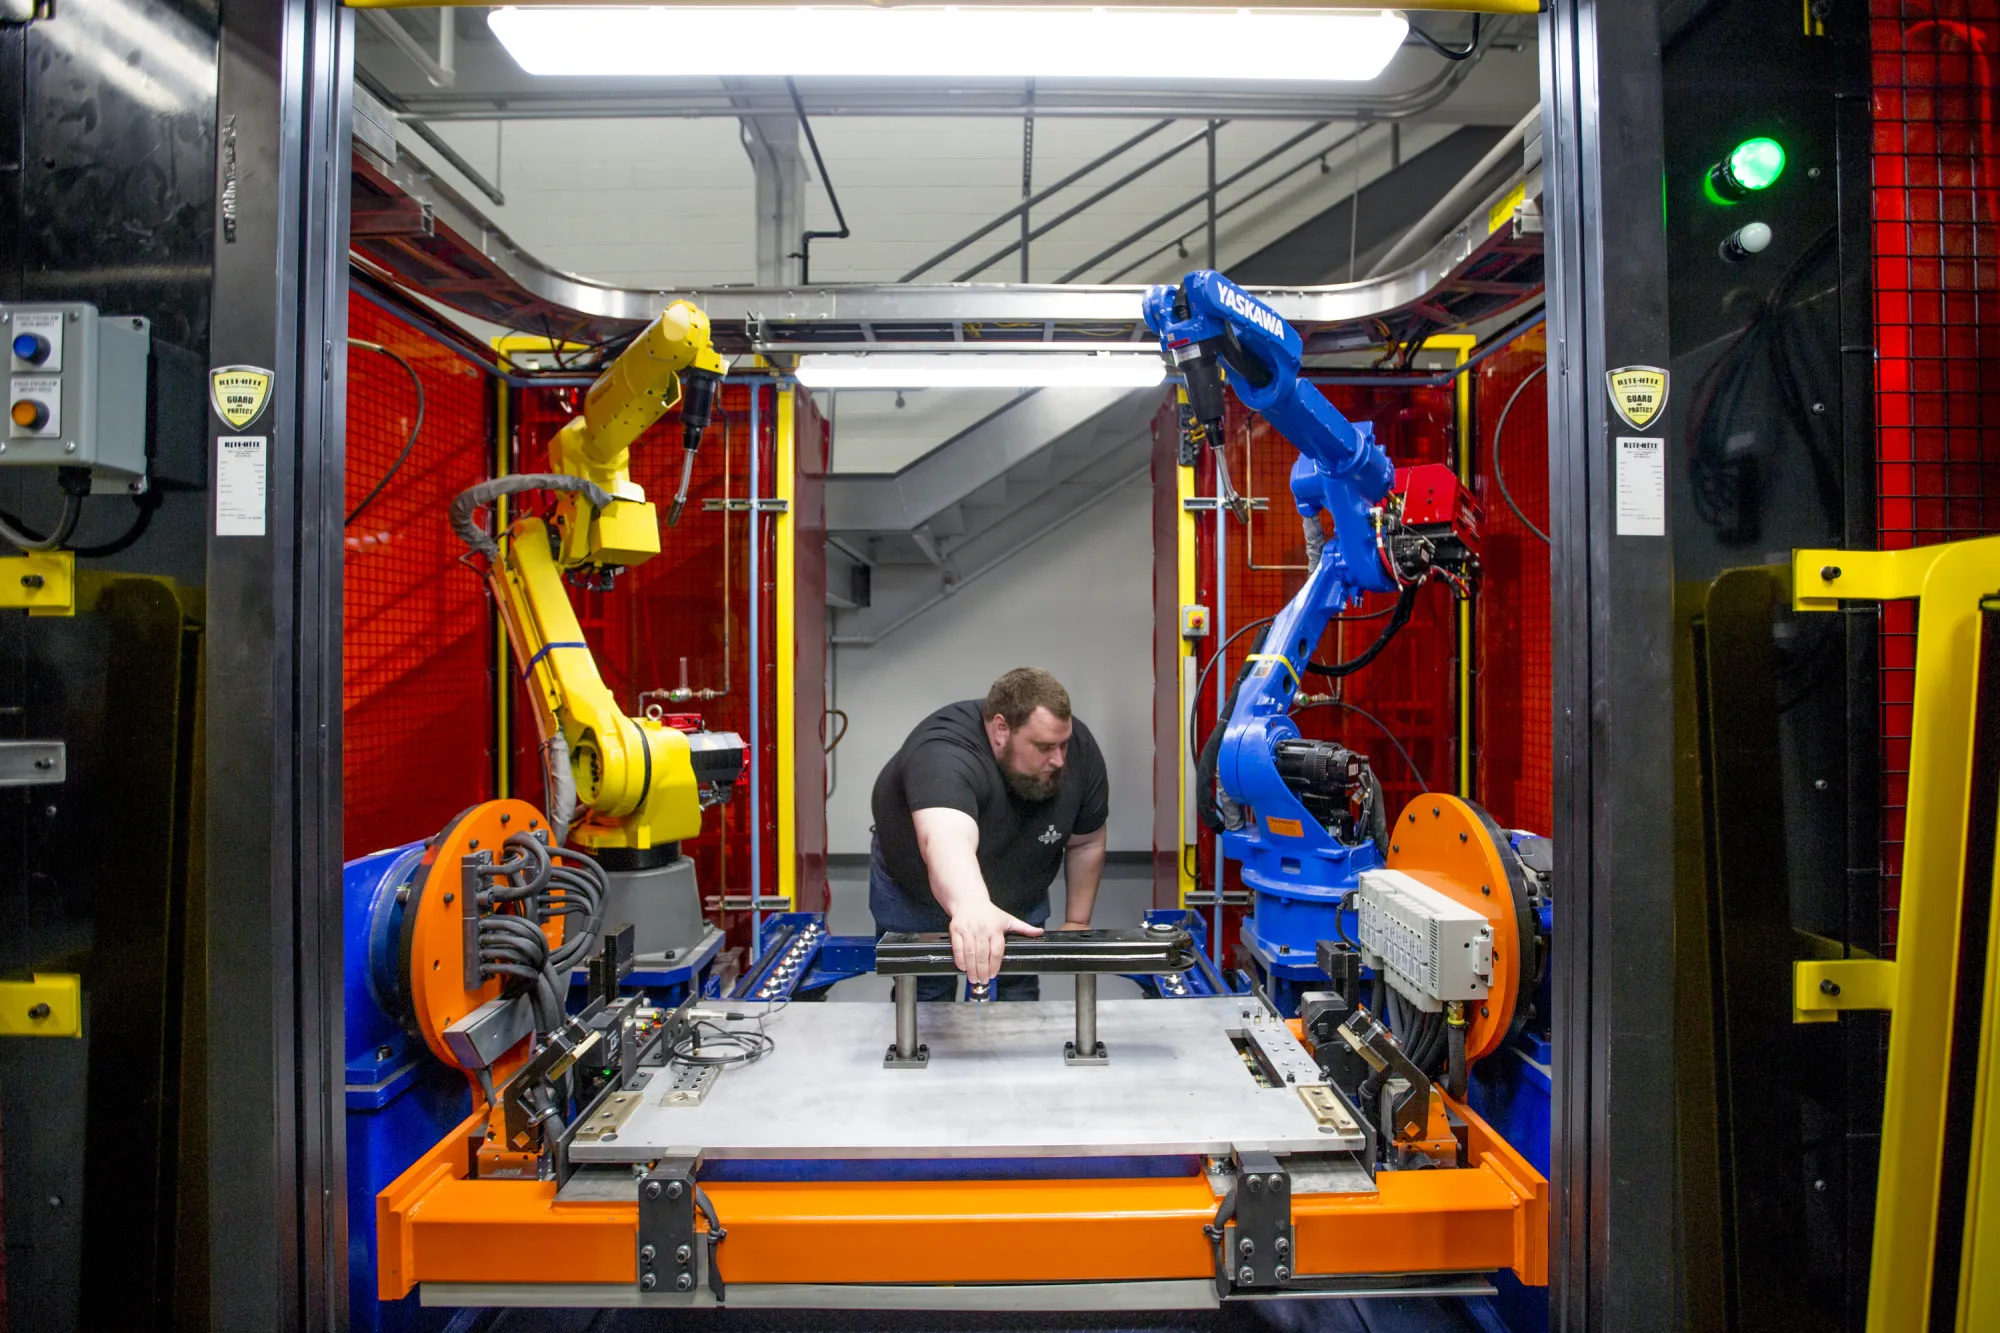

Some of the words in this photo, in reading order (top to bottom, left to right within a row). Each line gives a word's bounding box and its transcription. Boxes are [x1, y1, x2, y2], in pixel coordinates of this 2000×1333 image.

[1217, 281, 1285, 341] YASKAWA
[227, 396, 253, 404] GUARD
[1626, 394, 1653, 403] GUARD
